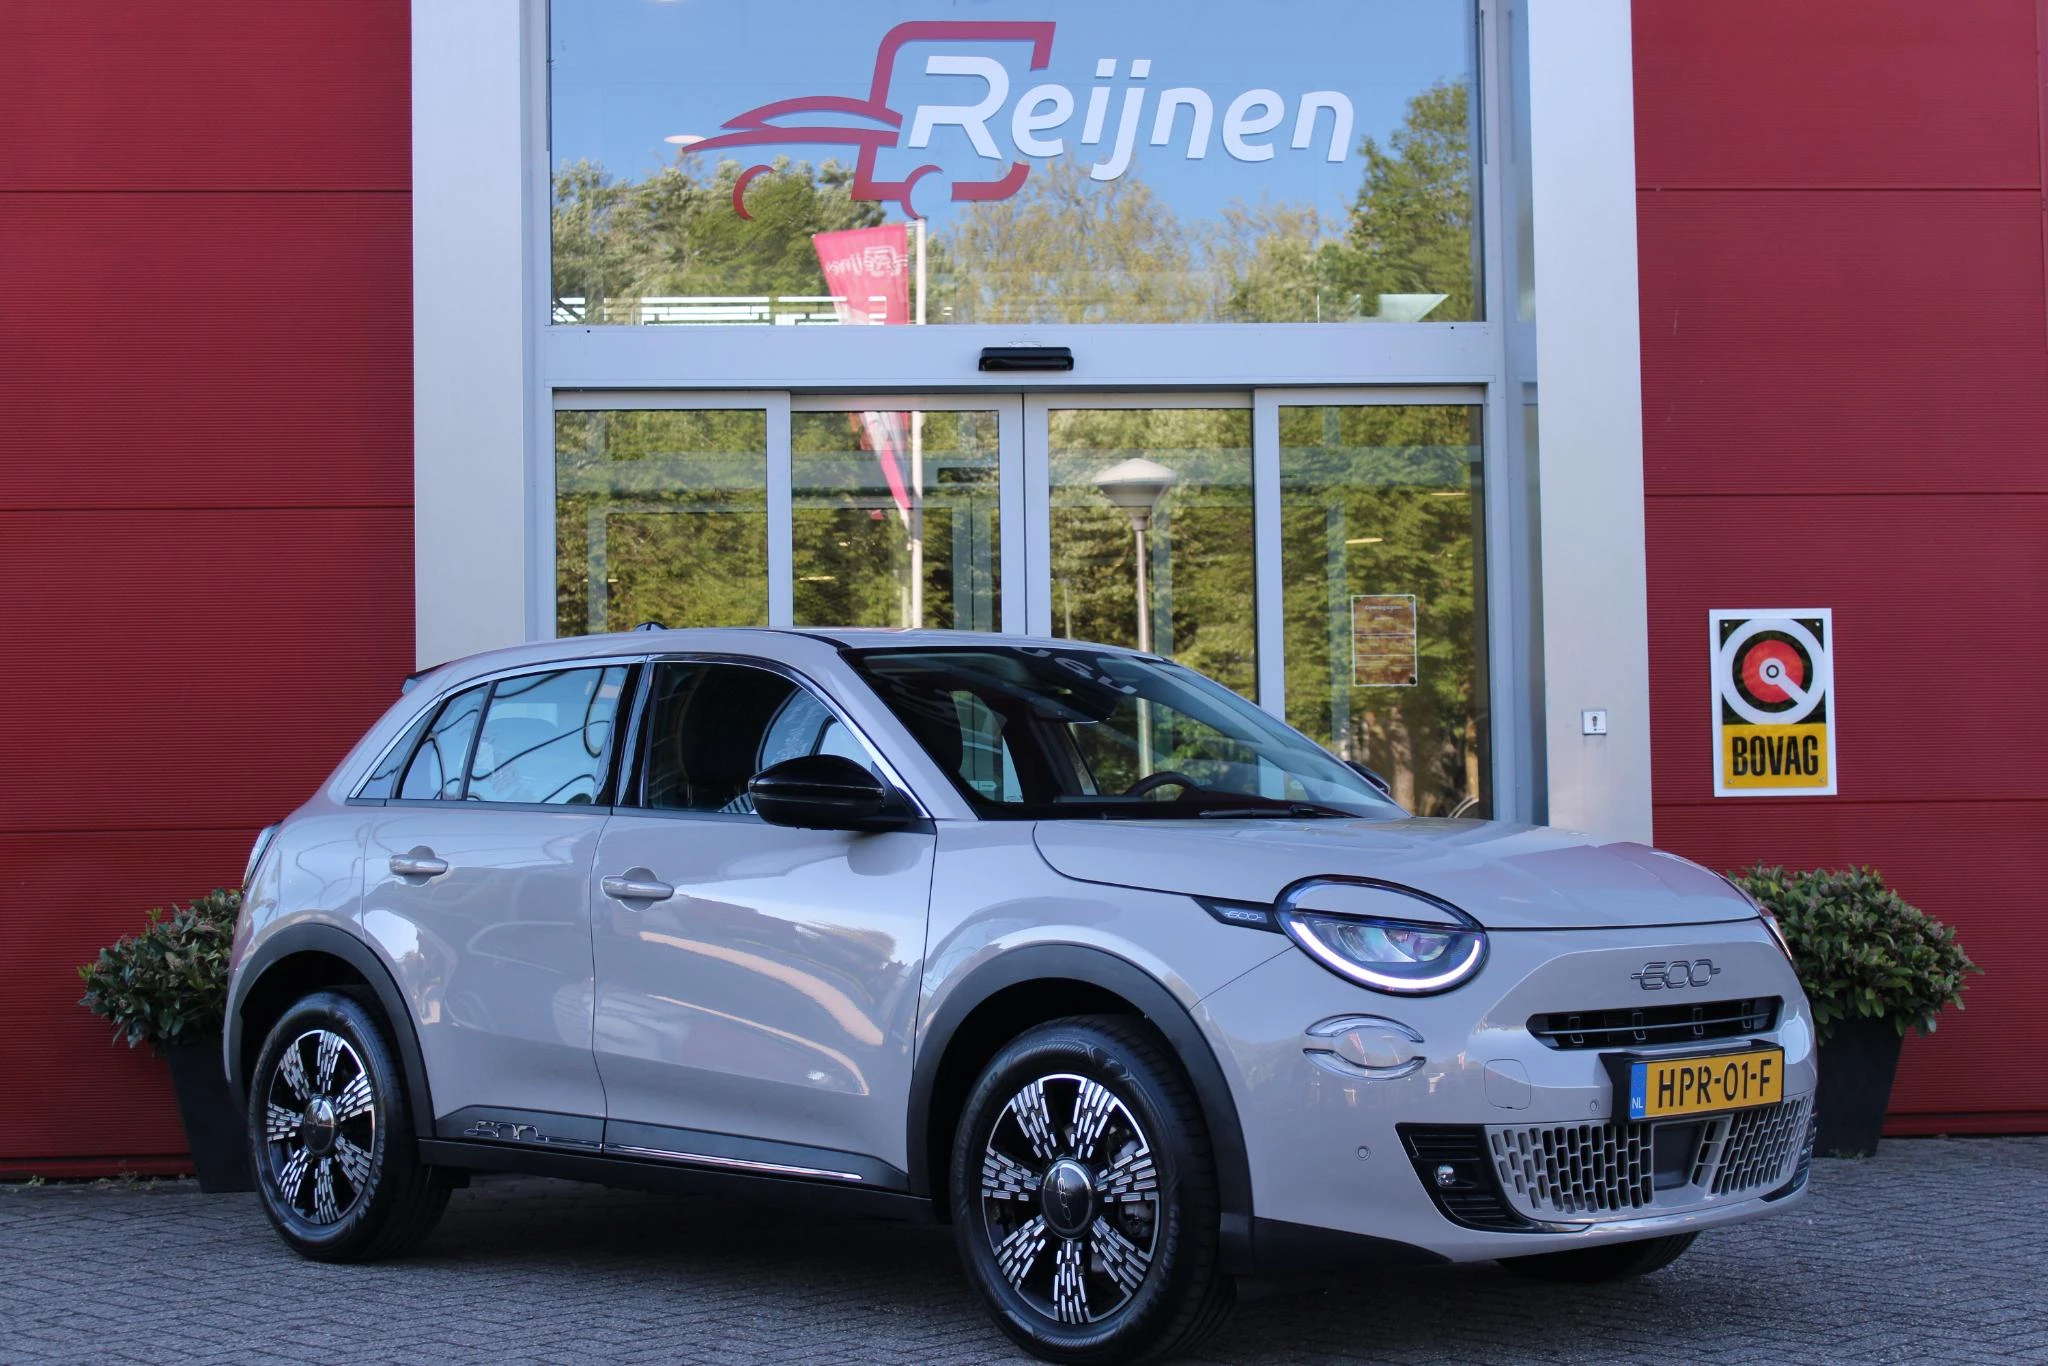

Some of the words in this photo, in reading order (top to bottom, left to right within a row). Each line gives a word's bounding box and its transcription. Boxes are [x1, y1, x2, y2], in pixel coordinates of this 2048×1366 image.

[909, 56, 1354, 182] Reijnen
[1732, 734, 1819, 777] BOVAG
[1638, 958, 1717, 991] 600
[1631, 1097, 1644, 1109] NL
[1657, 1058, 1772, 1109] HPR-01-F
